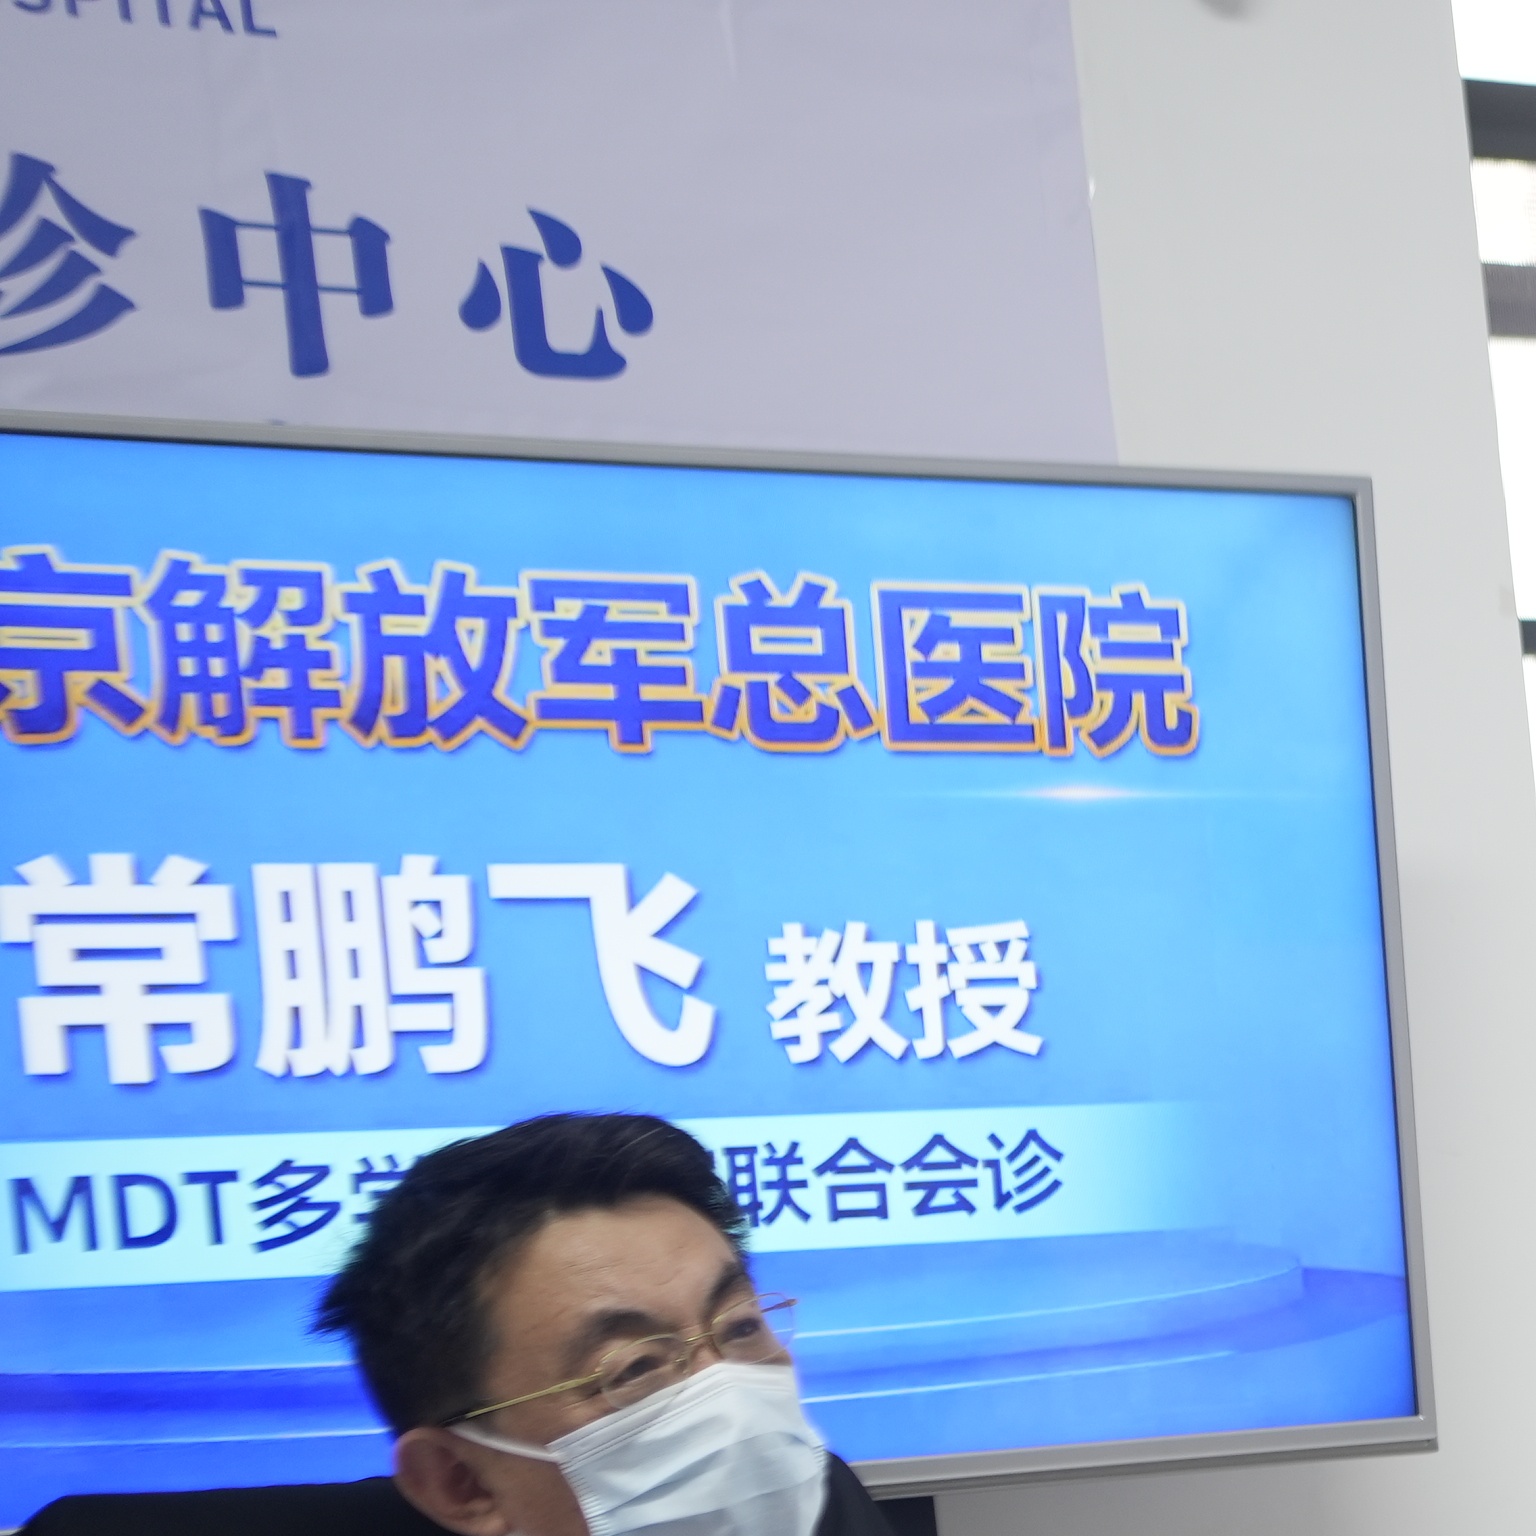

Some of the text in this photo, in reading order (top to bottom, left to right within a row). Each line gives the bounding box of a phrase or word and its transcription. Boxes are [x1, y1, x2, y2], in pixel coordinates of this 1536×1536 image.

[0, 545, 1200, 758] 京解放军总医院
[0, 852, 1044, 1086] 常鹏飞 教授
